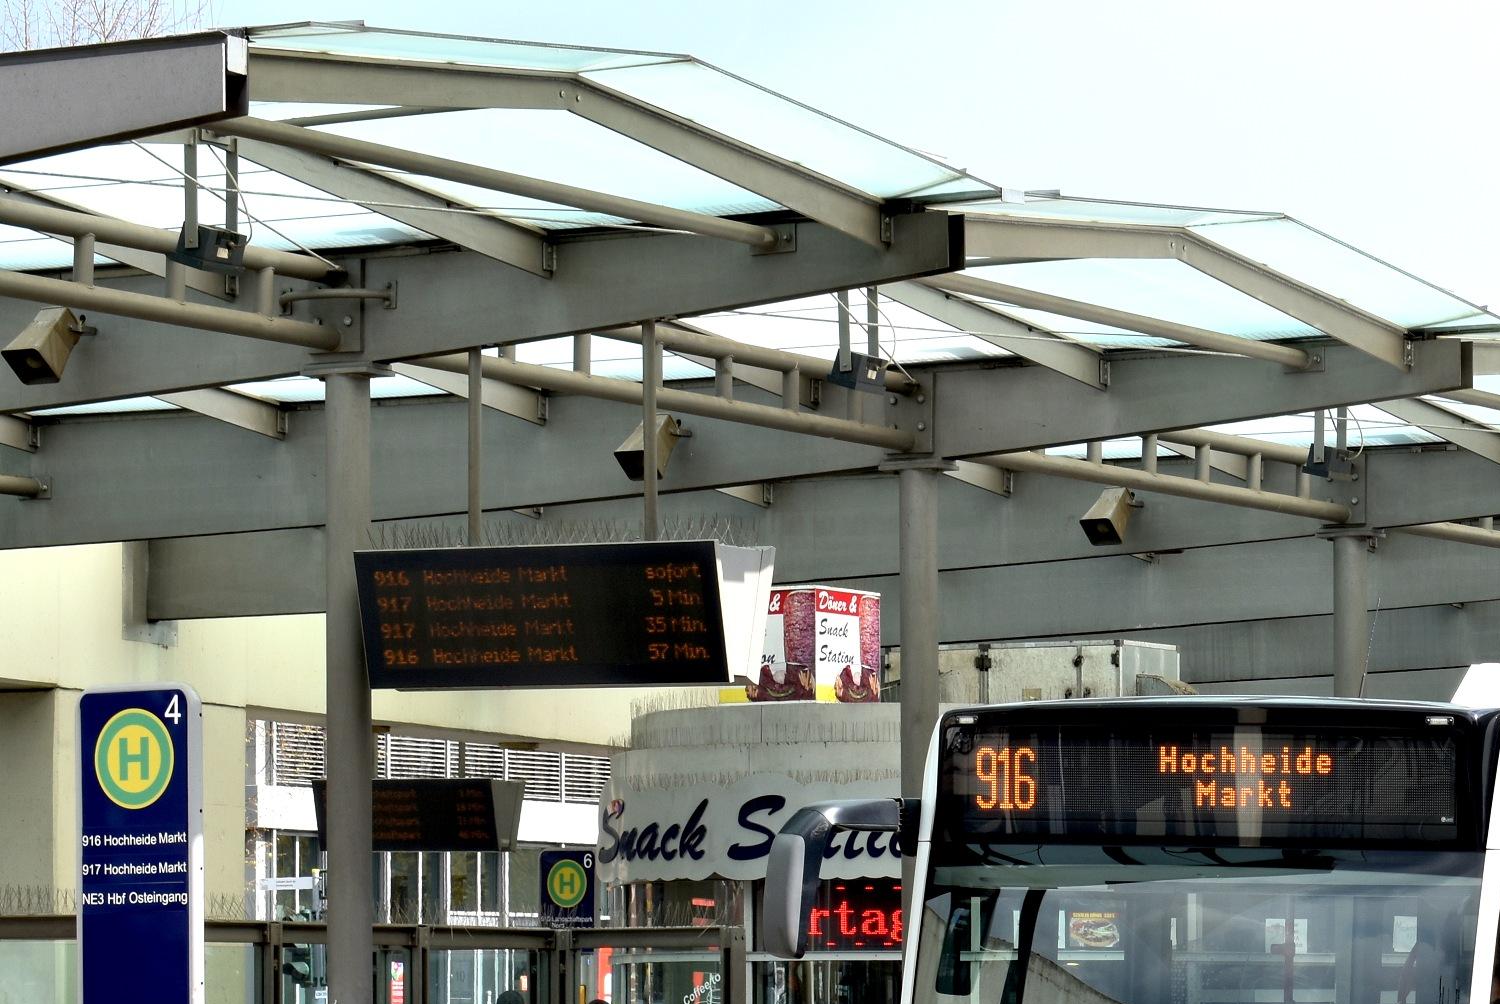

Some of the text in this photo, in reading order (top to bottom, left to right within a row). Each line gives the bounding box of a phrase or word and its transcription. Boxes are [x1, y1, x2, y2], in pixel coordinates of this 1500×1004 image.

[373, 570, 410, 587] 916
[423, 568, 510, 586] Hochheide
[518, 564, 569, 582] Markt
[377, 596, 412, 613] 917
[426, 594, 514, 612] Hochheide
[521, 592, 573, 608] Markt
[652, 590, 664, 606] 5
[818, 591, 857, 613] Döner &
[380, 622, 416, 639] 917
[429, 620, 517, 639] Hochheide
[525, 617, 575, 635] Markt
[645, 616, 667, 633] 35
[819, 618, 848, 637] Snack
[384, 649, 419, 665] 916
[432, 646, 520, 664] Hochheide
[527, 645, 578, 662] Markt
[648, 643, 669, 660] 57
[819, 645, 855, 664] Station
[164, 694, 182, 725] 4
[1158, 746, 1333, 775] Hochheide
[975, 747, 1036, 811] 916
[1195, 780, 1293, 808] Markt
[82, 831, 187, 847] 916 Hochheide Markt
[598, 798, 709, 864] Snack
[82, 860, 187, 876] 917 Hochheide Markt
[583, 853, 593, 869] 6
[82, 891, 188, 907] NE3 Hbf Osteingang
